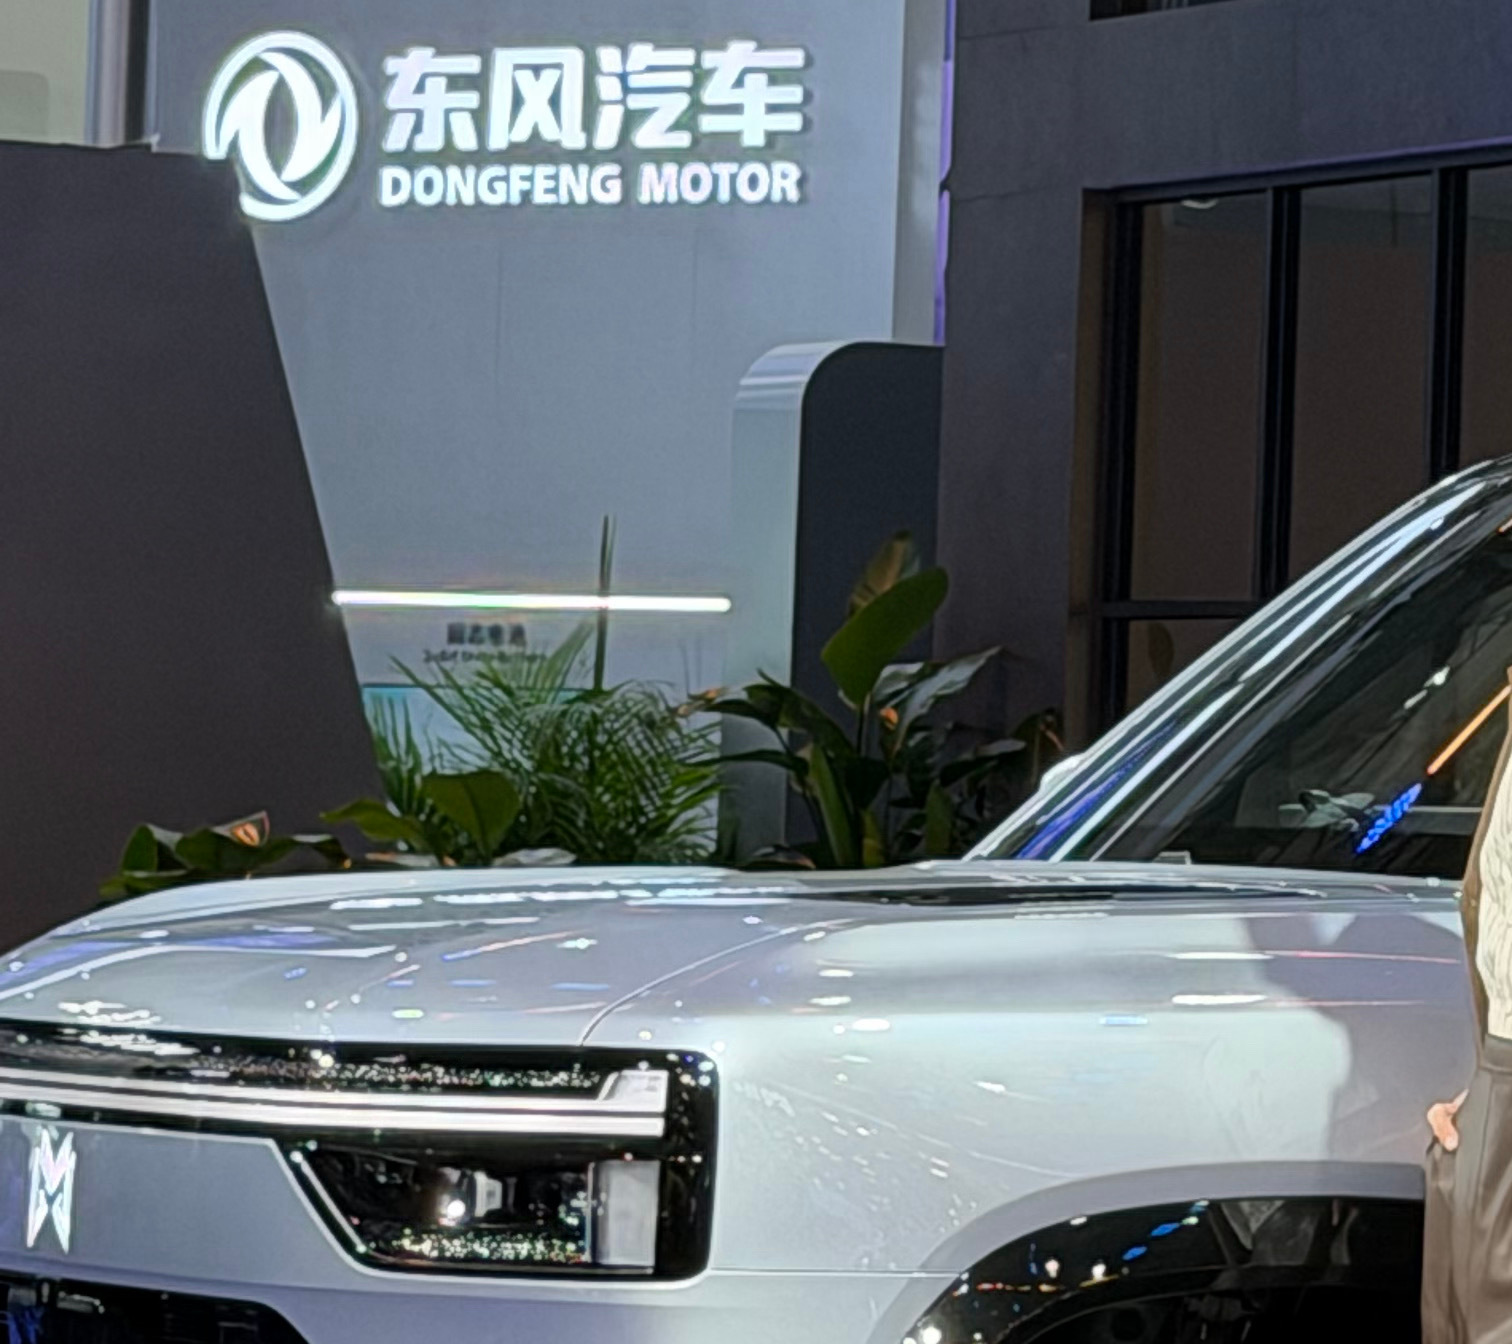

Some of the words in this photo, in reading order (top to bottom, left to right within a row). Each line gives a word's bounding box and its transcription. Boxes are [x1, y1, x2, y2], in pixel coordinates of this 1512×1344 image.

[383, 40, 805, 152] 东风汽车
[380, 161, 622, 207] DONGFENG
[638, 160, 801, 205] MOTOR
